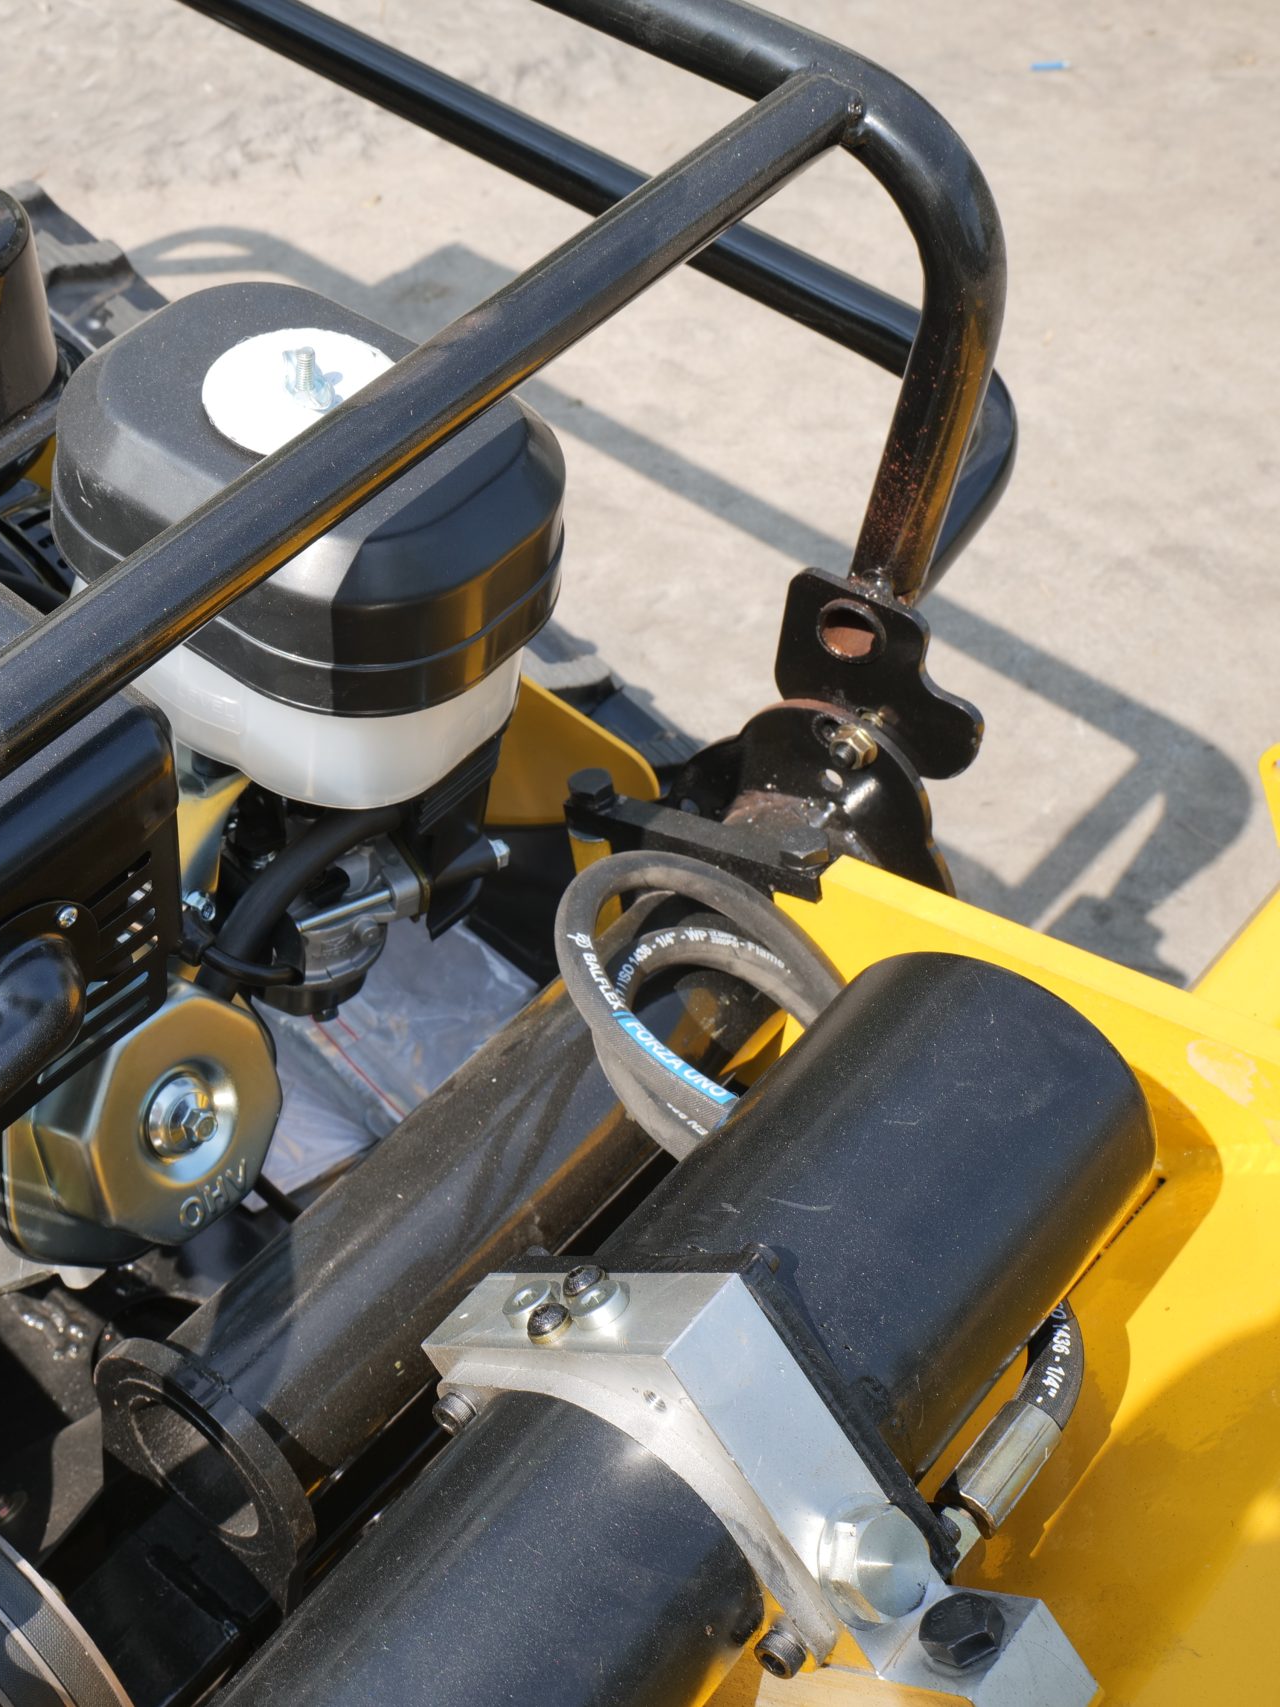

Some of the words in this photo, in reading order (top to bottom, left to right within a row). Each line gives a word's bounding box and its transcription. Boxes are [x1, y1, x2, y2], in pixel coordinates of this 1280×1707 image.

[618, 963, 635, 985] ISO
[629, 943, 653, 968] 1436
[582, 952, 625, 1011] BALFLEX
[625, 1021, 684, 1070] FORZA
[683, 1069, 728, 1097] UNO
[179, 1157, 246, 1228] OHV
[1052, 1322, 1072, 1356] 1436
